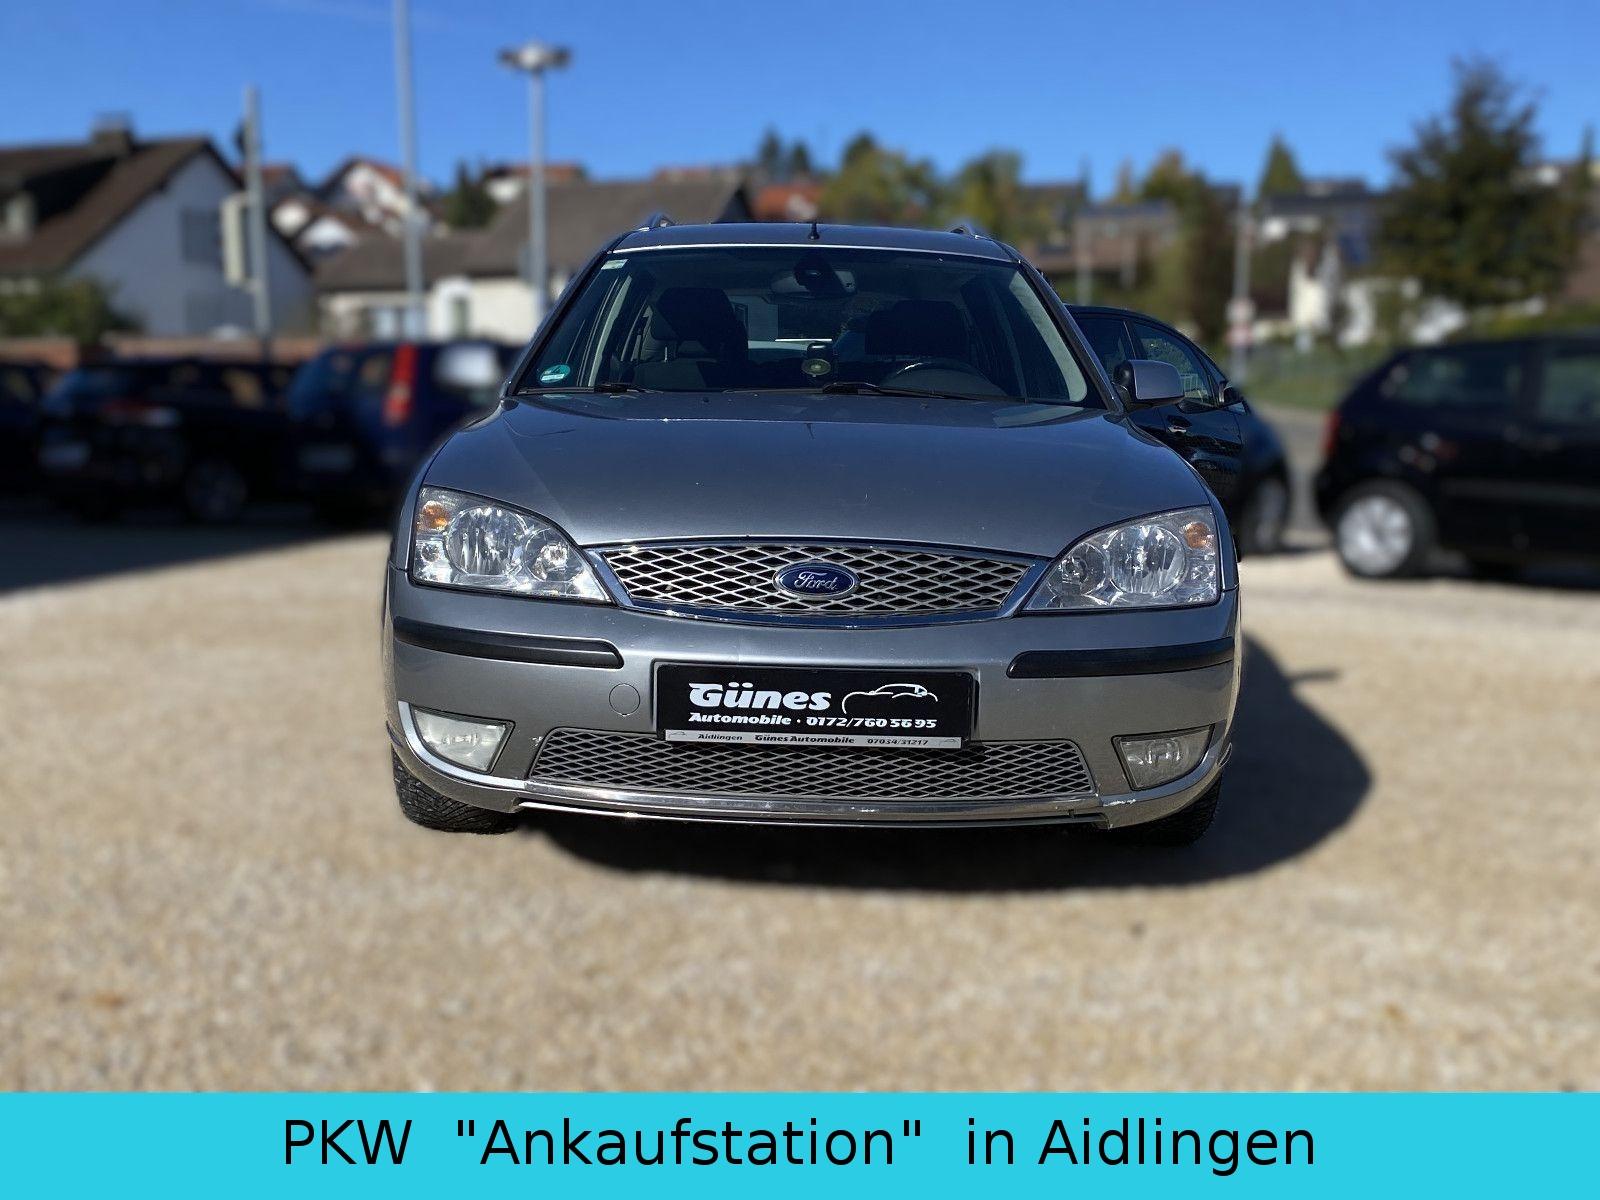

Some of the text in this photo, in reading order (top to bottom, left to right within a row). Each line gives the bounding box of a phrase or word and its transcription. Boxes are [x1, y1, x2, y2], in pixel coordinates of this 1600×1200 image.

[794, 571, 838, 590] Ford
[688, 681, 832, 711] Günes
[688, 712, 792, 725] Automobile
[806, 716, 887, 728] 0172/760
[914, 719, 938, 729] 95
[697, 733, 743, 743] Aidlingen
[754, 734, 788, 742] Günes
[789, 735, 855, 744] Automobile
